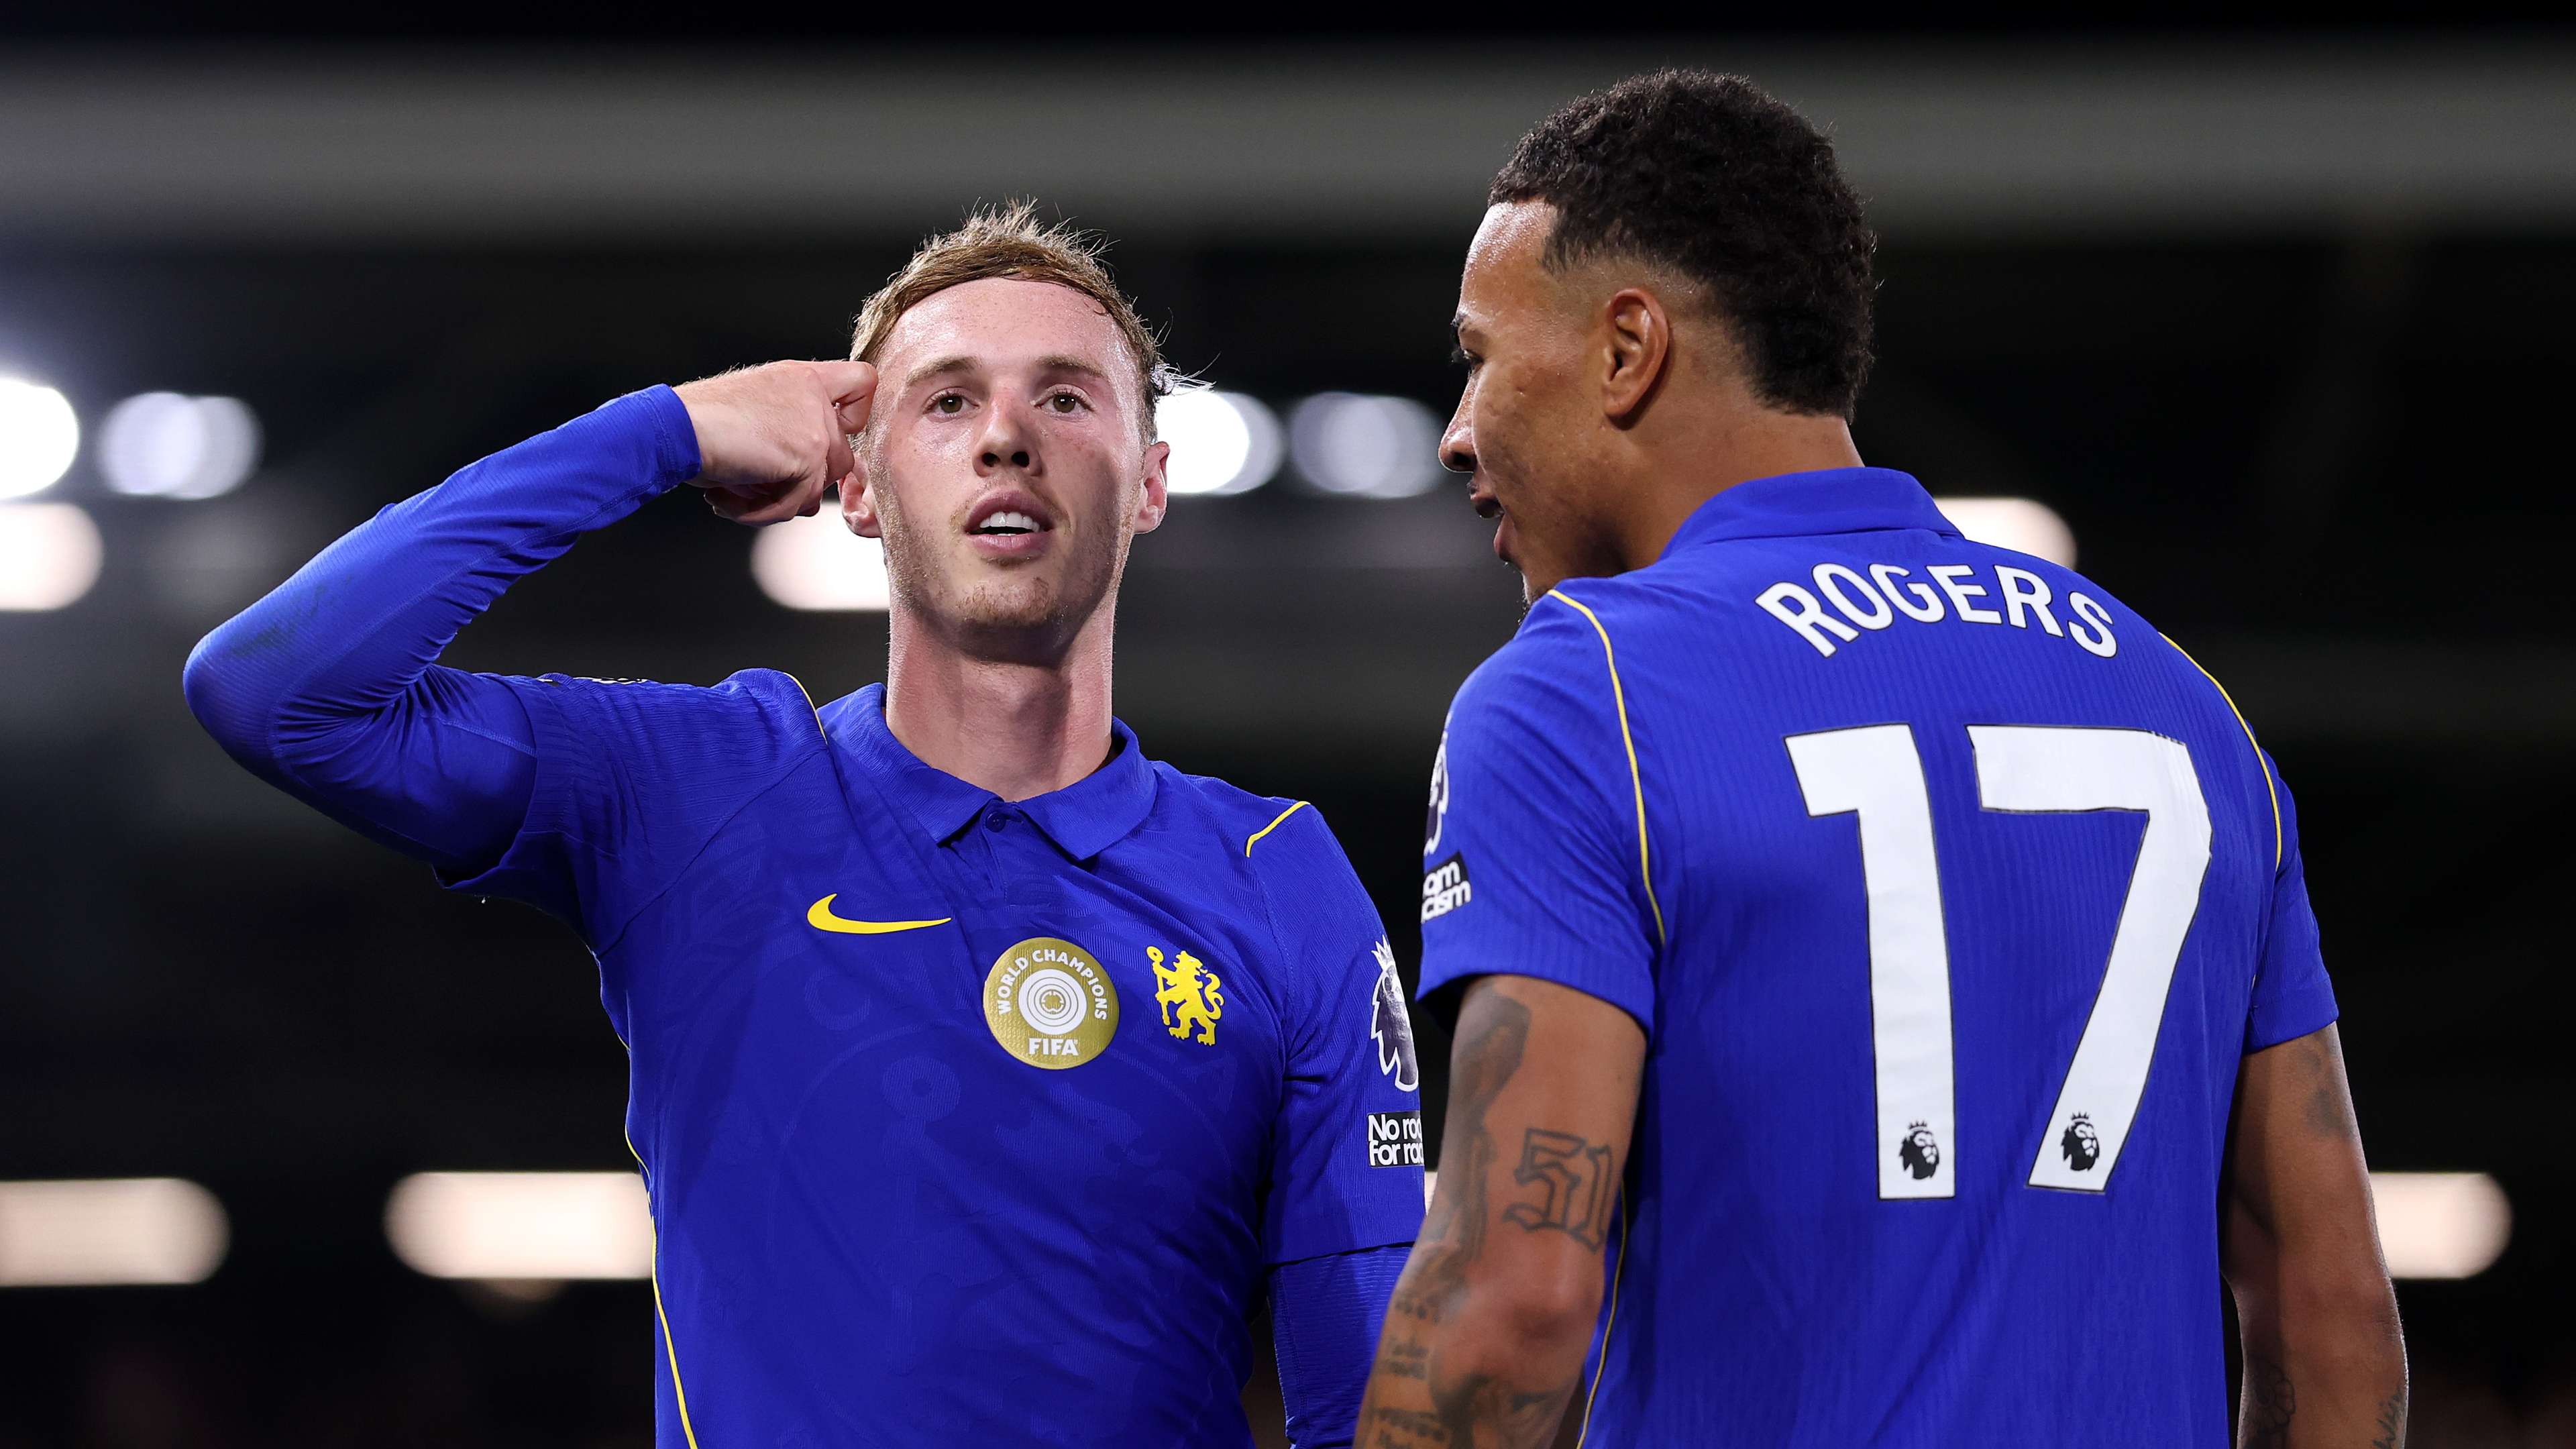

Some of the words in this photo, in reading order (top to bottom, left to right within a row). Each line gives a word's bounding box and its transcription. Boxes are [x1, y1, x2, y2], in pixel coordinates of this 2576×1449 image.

[1755, 563, 2118, 658] ROGERS
[997, 956, 1029, 1016] WORLD
[1032, 949, 1108, 1020] CHAMPIONS
[1784, 724, 2213, 1199] 17
[1028, 1037, 1079, 1056] FIFA
[1368, 1114, 1400, 1142] No
[1502, 1127, 1612, 1254] 51
